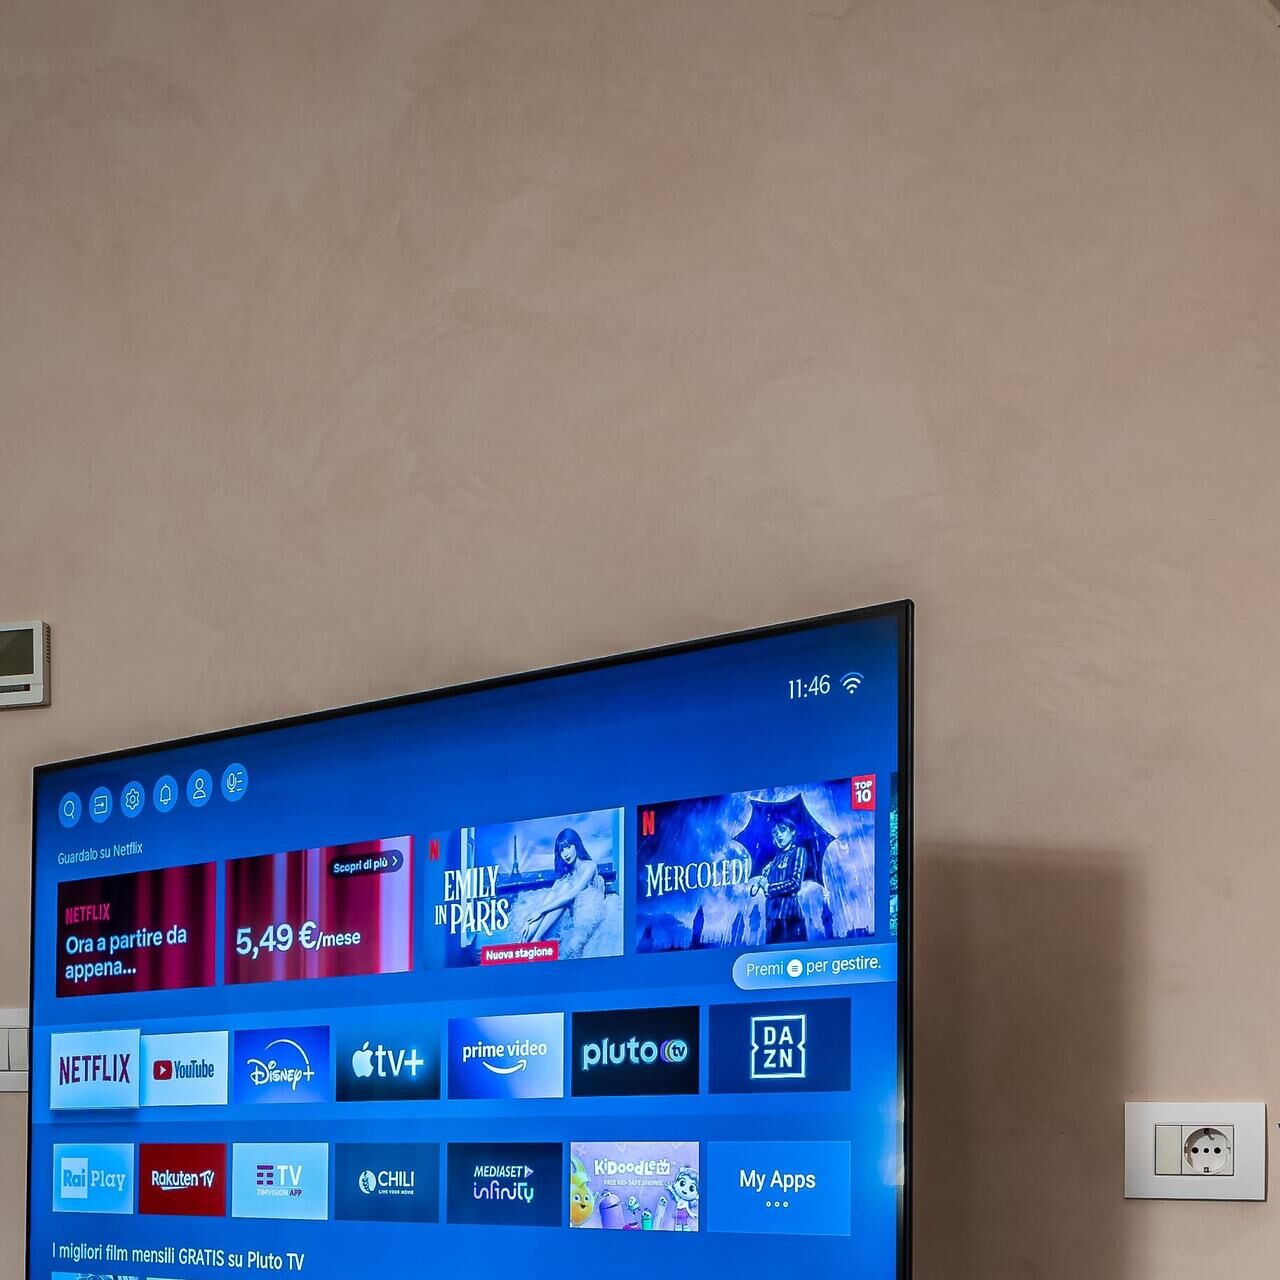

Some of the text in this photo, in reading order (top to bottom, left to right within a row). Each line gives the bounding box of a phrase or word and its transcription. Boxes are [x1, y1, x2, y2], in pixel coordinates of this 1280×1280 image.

[788, 674, 831, 700] 11:46
[854, 780, 873, 790] TOP
[855, 788, 872, 804] 10
[57, 841, 144, 865] Guardalo su Netflix
[333, 856, 388, 874] Scopri di più
[444, 865, 499, 902] EMILY
[65, 903, 110, 925] NETFLIX
[434, 898, 509, 937] IN PARIS
[65, 924, 187, 955] Ora a partire da
[236, 923, 294, 960] 5,49
[486, 946, 553, 960] Nuova stagione
[65, 960, 137, 983] appena...
[746, 955, 882, 977] Premi per gestire.
[462, 1040, 548, 1063] prime video
[582, 1037, 687, 1071] pluto tv
[58, 1053, 131, 1086] NETFLIX
[174, 1059, 215, 1079] YouTube
[63, 1168, 126, 1191] Rai Play
[151, 1169, 214, 1190] Rakuten TV
[277, 1165, 303, 1186] TV
[377, 1171, 415, 1187] CHILI
[473, 1165, 524, 1178] MEDIASET
[739, 1169, 816, 1190] My Apps
[256, 1188, 302, 1197] TIMVISION APP
[473, 1180, 534, 1203] infinity
[52, 1242, 305, 1271] I migliori film mensili GRATIS su Pluto TV
